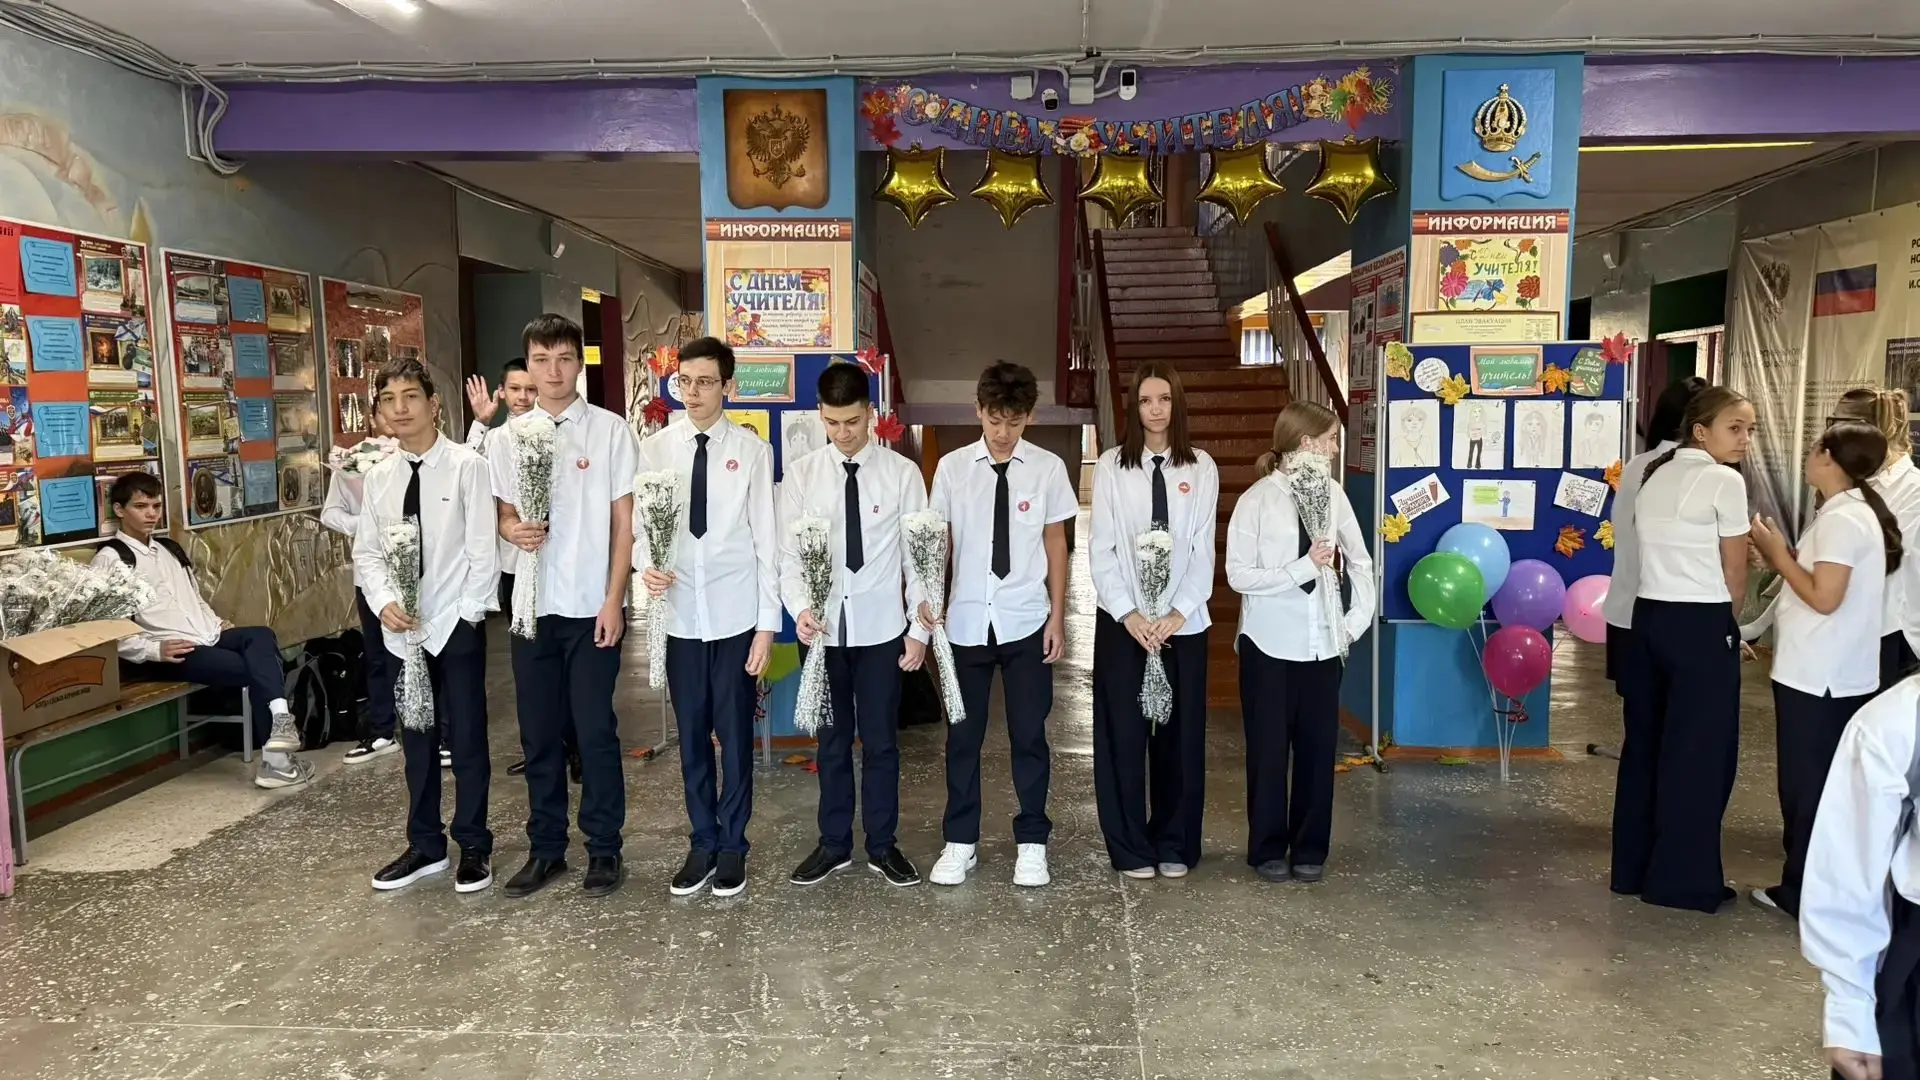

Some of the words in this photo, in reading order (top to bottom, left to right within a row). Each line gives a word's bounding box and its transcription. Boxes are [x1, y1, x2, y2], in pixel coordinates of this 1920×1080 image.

[1094, 84, 1308, 156] УЧИТЕЛЯ!
[720, 223, 840, 239] ИНФОРМАЦИЯ
[1428, 215, 1557, 231] ИНФОРМАЦИЯ
[1473, 260, 1538, 275] УЧИТЕЛЯ!
[729, 273, 742, 291] С
[747, 272, 801, 291] ДНЕМ
[731, 292, 826, 311] УЧИТЕЛЯ!
